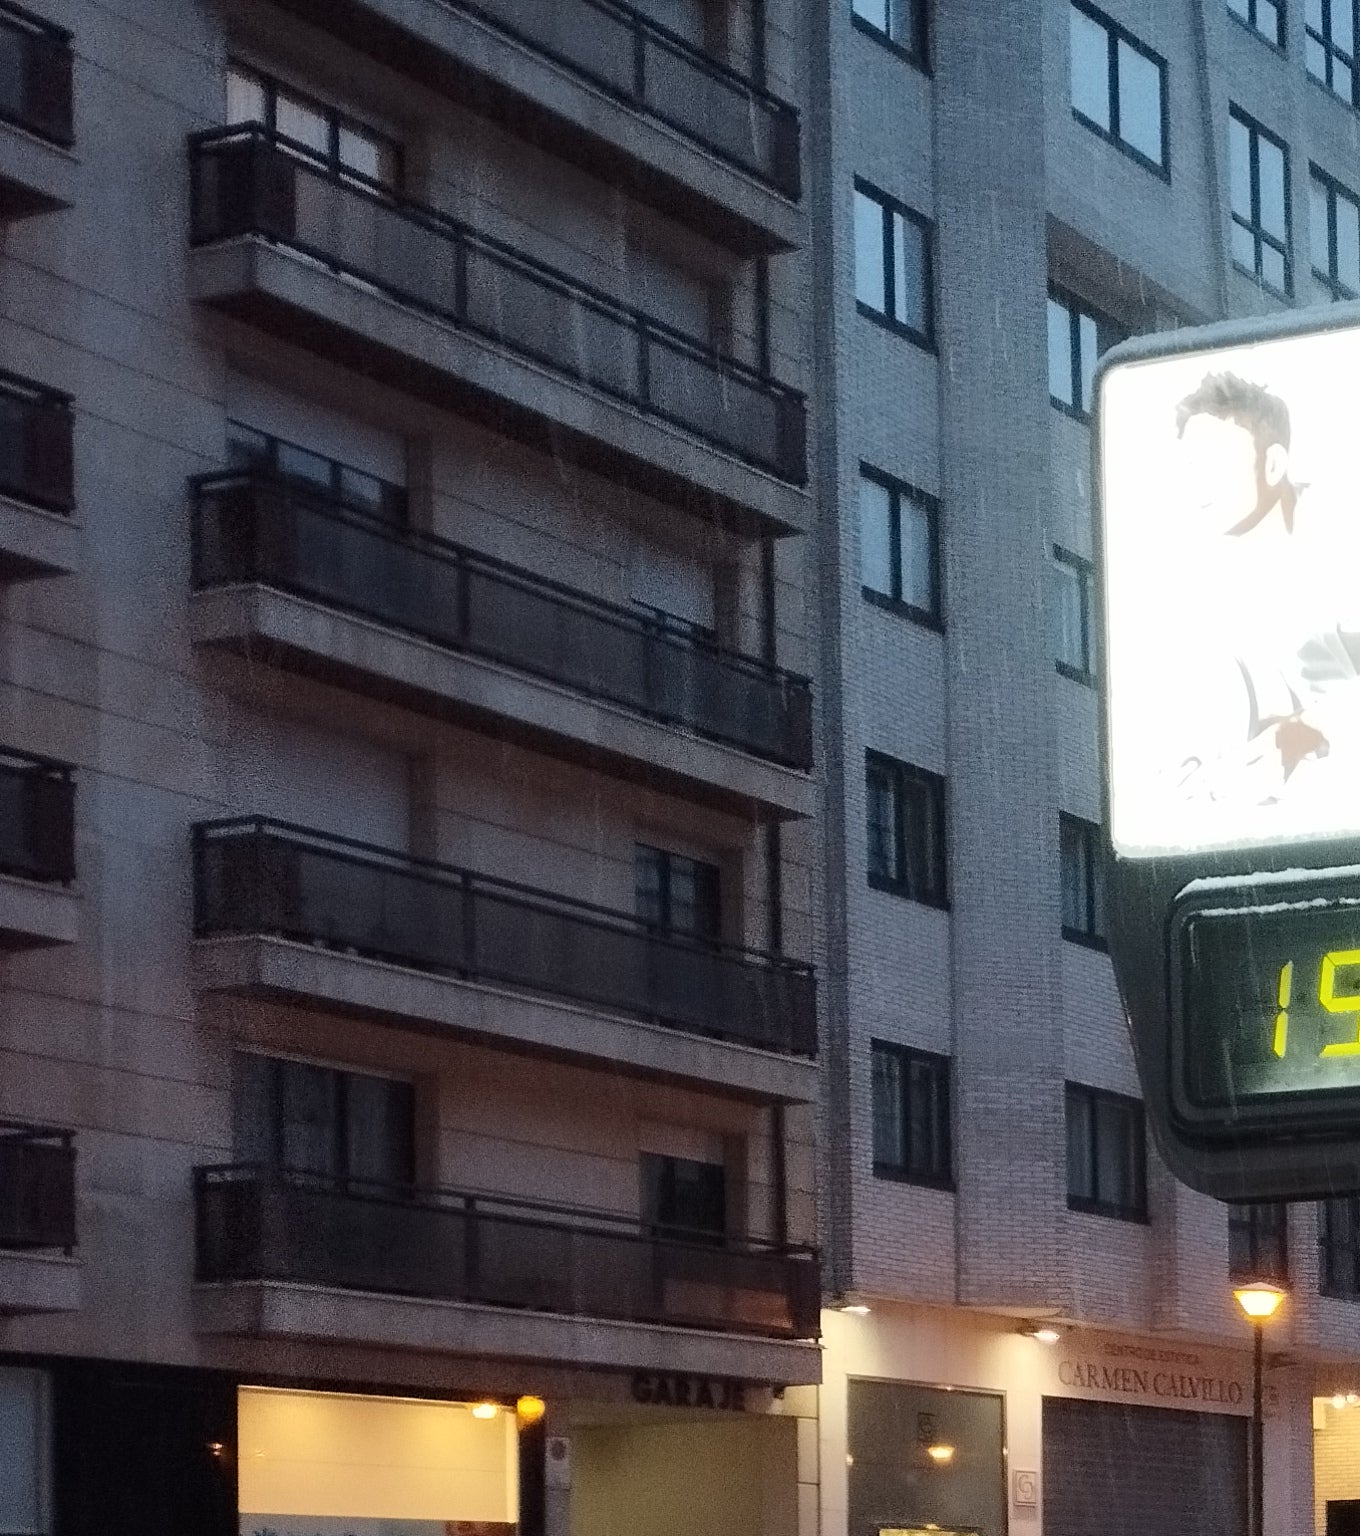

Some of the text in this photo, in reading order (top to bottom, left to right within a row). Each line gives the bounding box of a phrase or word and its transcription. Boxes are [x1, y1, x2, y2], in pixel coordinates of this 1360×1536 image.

[631, 1371, 747, 1411] GARAJE
[1058, 1360, 1148, 1393] CARMEN
[1152, 1371, 1244, 1404] CALVILLO
